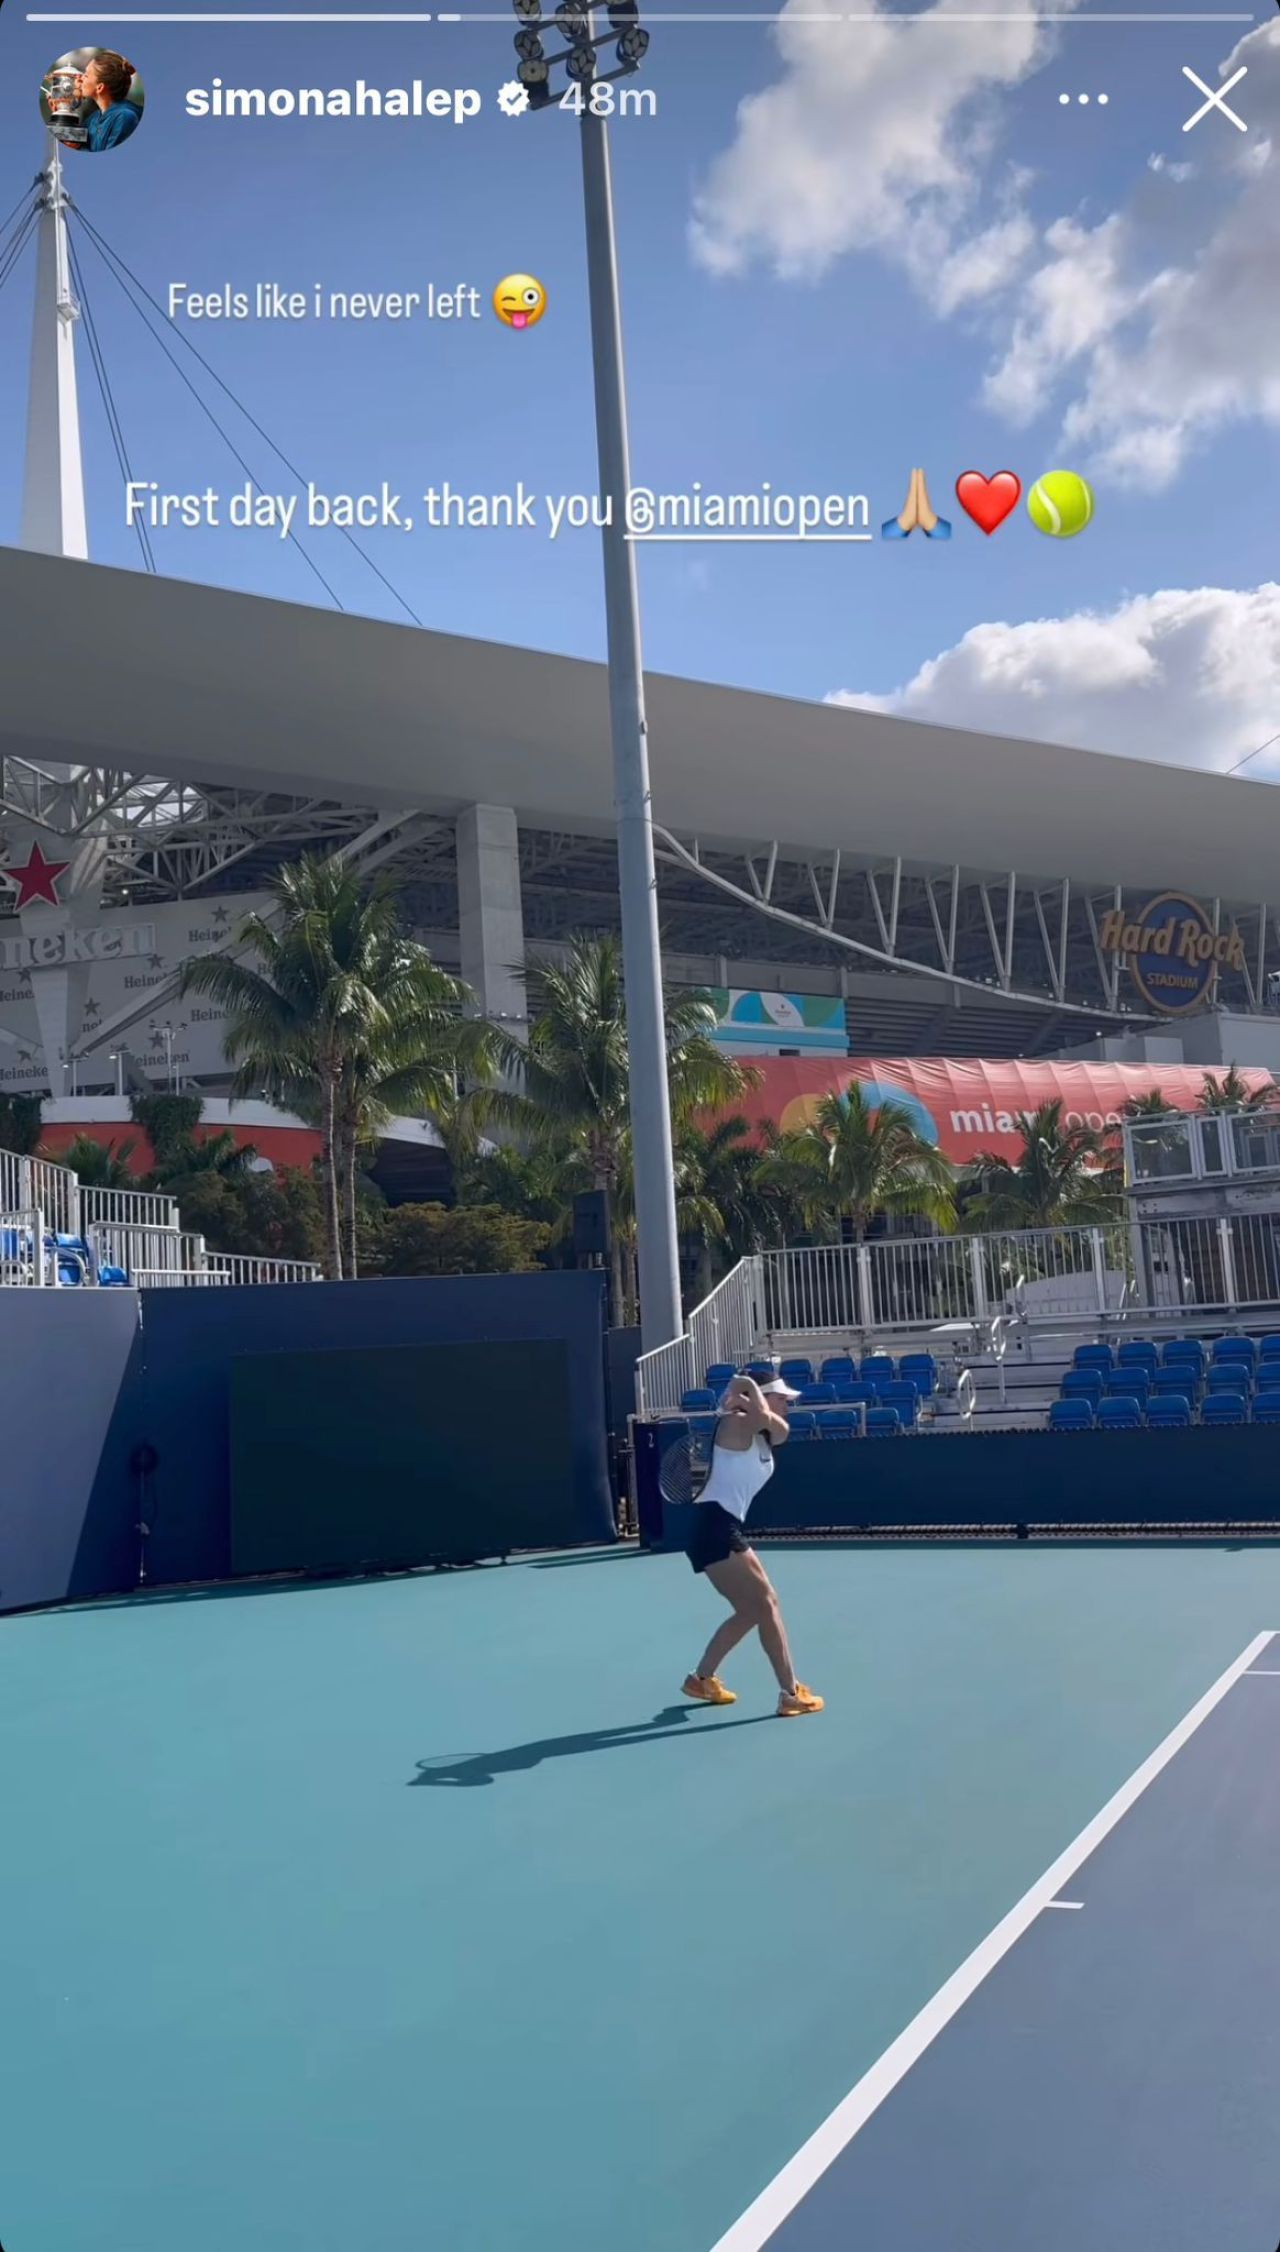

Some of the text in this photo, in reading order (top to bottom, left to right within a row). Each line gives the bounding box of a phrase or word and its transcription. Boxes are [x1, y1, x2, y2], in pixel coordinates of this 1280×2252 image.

[1102, 910, 1245, 971] Hard Rock
[1146, 973, 1198, 990] STADIUM
[1065, 1112, 1122, 1133] ope
